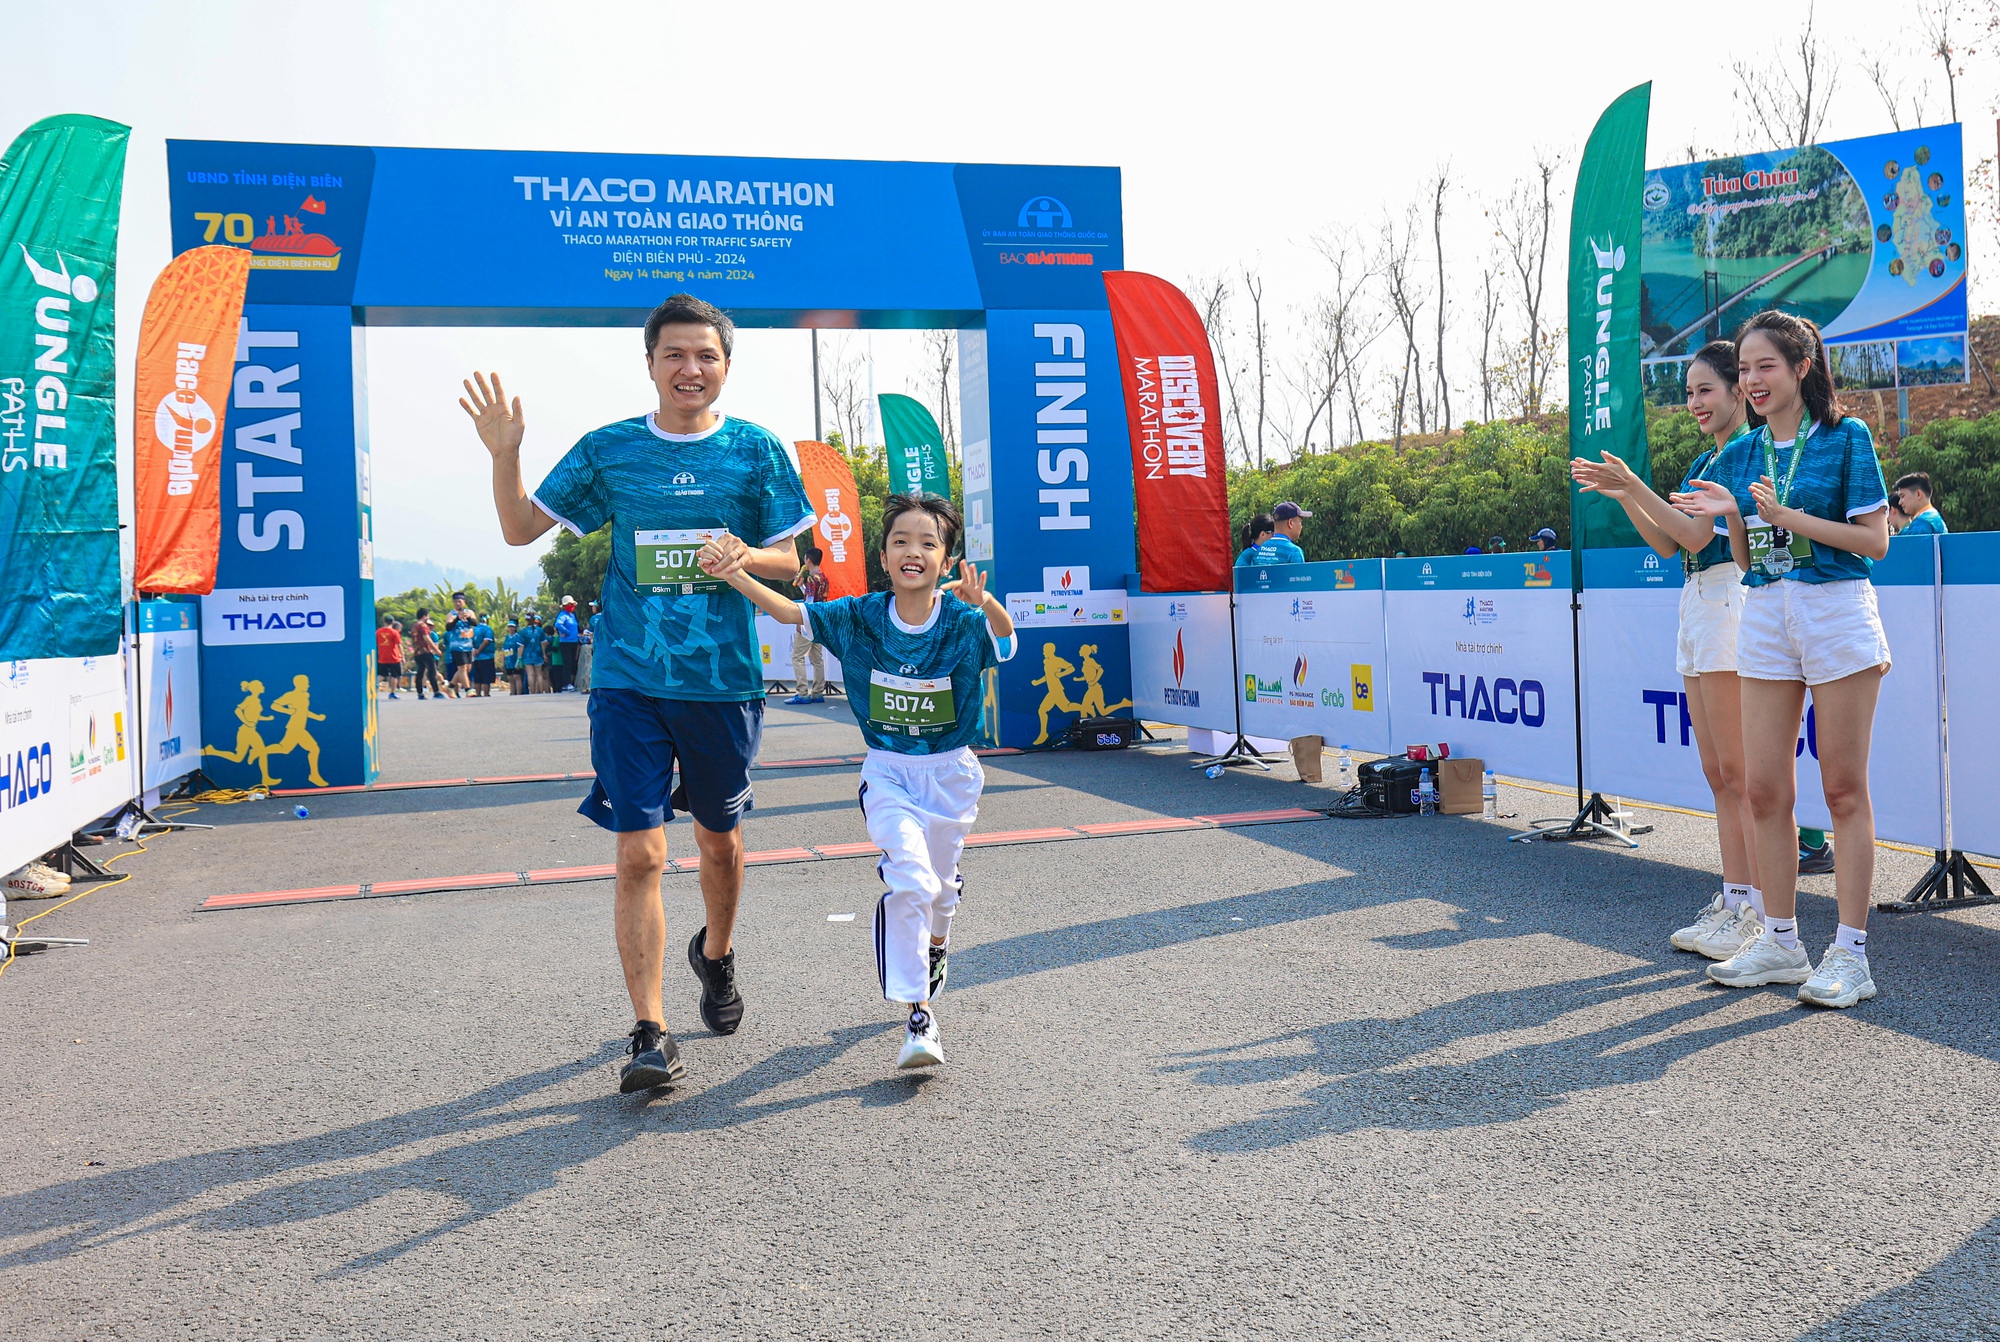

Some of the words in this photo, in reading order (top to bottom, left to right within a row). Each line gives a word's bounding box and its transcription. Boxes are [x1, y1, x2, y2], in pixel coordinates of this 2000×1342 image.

[186, 171, 229, 185] UBND
[232, 169, 268, 186] TỈNH
[271, 172, 306, 190] ĐIỆN
[310, 173, 343, 188] BIÊN
[513, 175, 656, 203] THACO
[666, 179, 835, 207] MARATHON
[194, 211, 255, 243] 70
[550, 205, 572, 227] VÌ
[577, 210, 608, 228] AN
[613, 207, 672, 229] TOÀN
[677, 212, 727, 230] GIAO
[732, 210, 804, 231] THÔNG
[562, 234, 603, 245] THACO
[605, 234, 673, 246] MARATHON
[675, 235, 699, 246] FOR
[700, 236, 748, 247] TRAFFIC
[750, 237, 793, 248] SAFETY
[992, 230, 1007, 238] BAN
[612, 250, 643, 266] ĐIỆN
[646, 249, 675, 263] BIÊN
[677, 250, 703, 264] PHỦ
[714, 253, 746, 265] 2024
[604, 268, 634, 282] Ngày
[637, 268, 649, 279] 14
[651, 268, 685, 282] tháng
[687, 269, 695, 279] 4
[697, 269, 723, 280] năm
[725, 269, 755, 280] 2024
[1590, 229, 1626, 431] JUNGLE
[18, 242, 98, 468] JUNGLE
[174, 342, 207, 404] Race
[0, 378, 28, 473] PATHS
[1033, 323, 1091, 531] FINISH
[1134, 356, 1165, 480] MARATHON
[1157, 355, 1207, 479] DISCOVERY
[234, 316, 306, 551] START
[904, 446, 923, 497] NGLE
[921, 444, 940, 480] PATHS
[655, 549, 701, 569] 507
[238, 594, 256, 603] Nhà
[258, 594, 270, 602] tài
[271, 594, 284, 603] trợ
[285, 593, 309, 602] chính
[1050, 589, 1084, 597] PETROVIETNAM
[221, 611, 327, 631] THACO
[1091, 612, 1108, 620] Grab
[1455, 641, 1467, 652] Nhà
[1468, 642, 1476, 653] tài
[1476, 643, 1486, 656] trợ
[1486, 642, 1503, 654] chính
[1163, 687, 1200, 708] PETROVIETNAM
[1321, 687, 1345, 708] Grab
[1355, 676, 1369, 699] be
[884, 692, 936, 713] 5074
[1423, 671, 1545, 728] THACO
[0, 741, 52, 812] HACO
[8, 880, 45, 893] BOSTON
